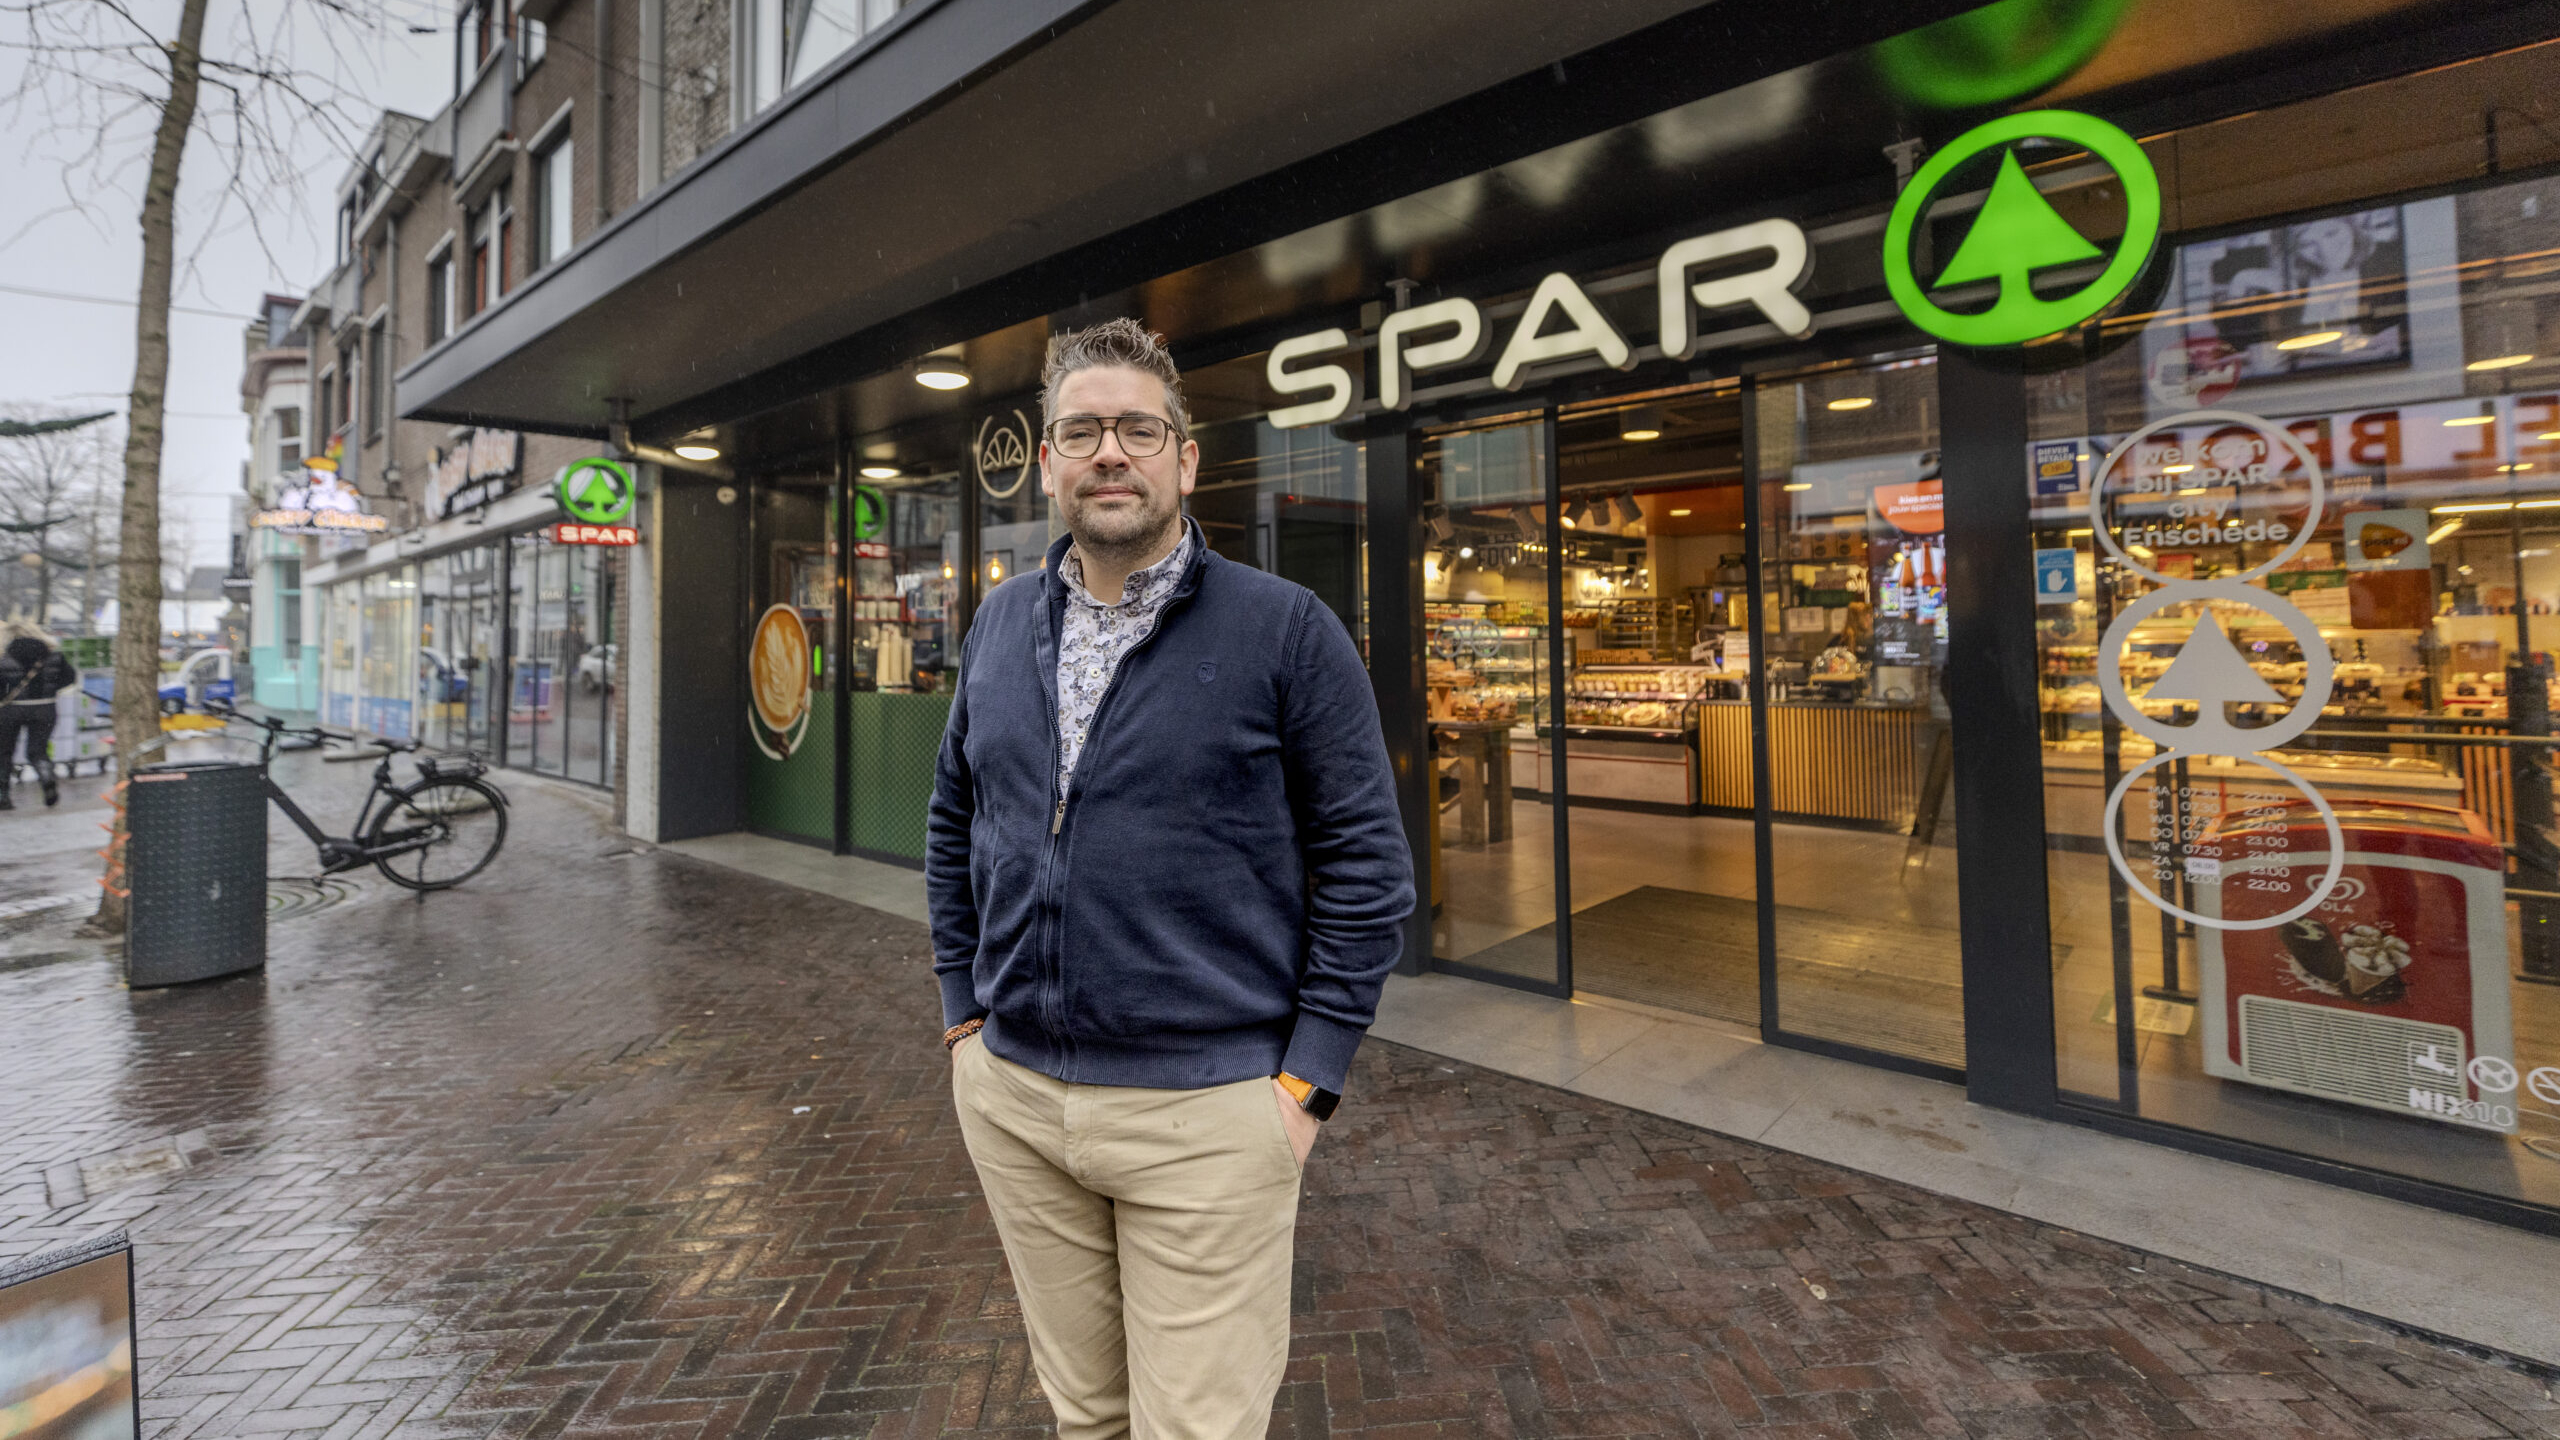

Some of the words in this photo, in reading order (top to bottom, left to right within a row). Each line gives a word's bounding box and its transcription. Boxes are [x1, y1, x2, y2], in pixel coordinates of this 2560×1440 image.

[1267, 217, 1812, 429] SPAR
[2135, 439, 2266, 464] welkom
[2135, 472, 2172, 496] bij
[2179, 463, 2270, 488] SPAR
[2168, 496, 2229, 520] city
[560, 525, 637, 544] SPAR
[2123, 518, 2289, 548] Enschede
[2148, 786, 2171, 796] MA
[2149, 799, 2164, 809] DI
[2150, 814, 2175, 824] WO
[2150, 828, 2174, 839] DO
[2150, 842, 2170, 852] VR
[2151, 855, 2171, 866] ZA
[2153, 870, 2174, 881] ZO
[2320, 900, 2354, 914] OLA
[2408, 1087, 2514, 1127] NIX18
